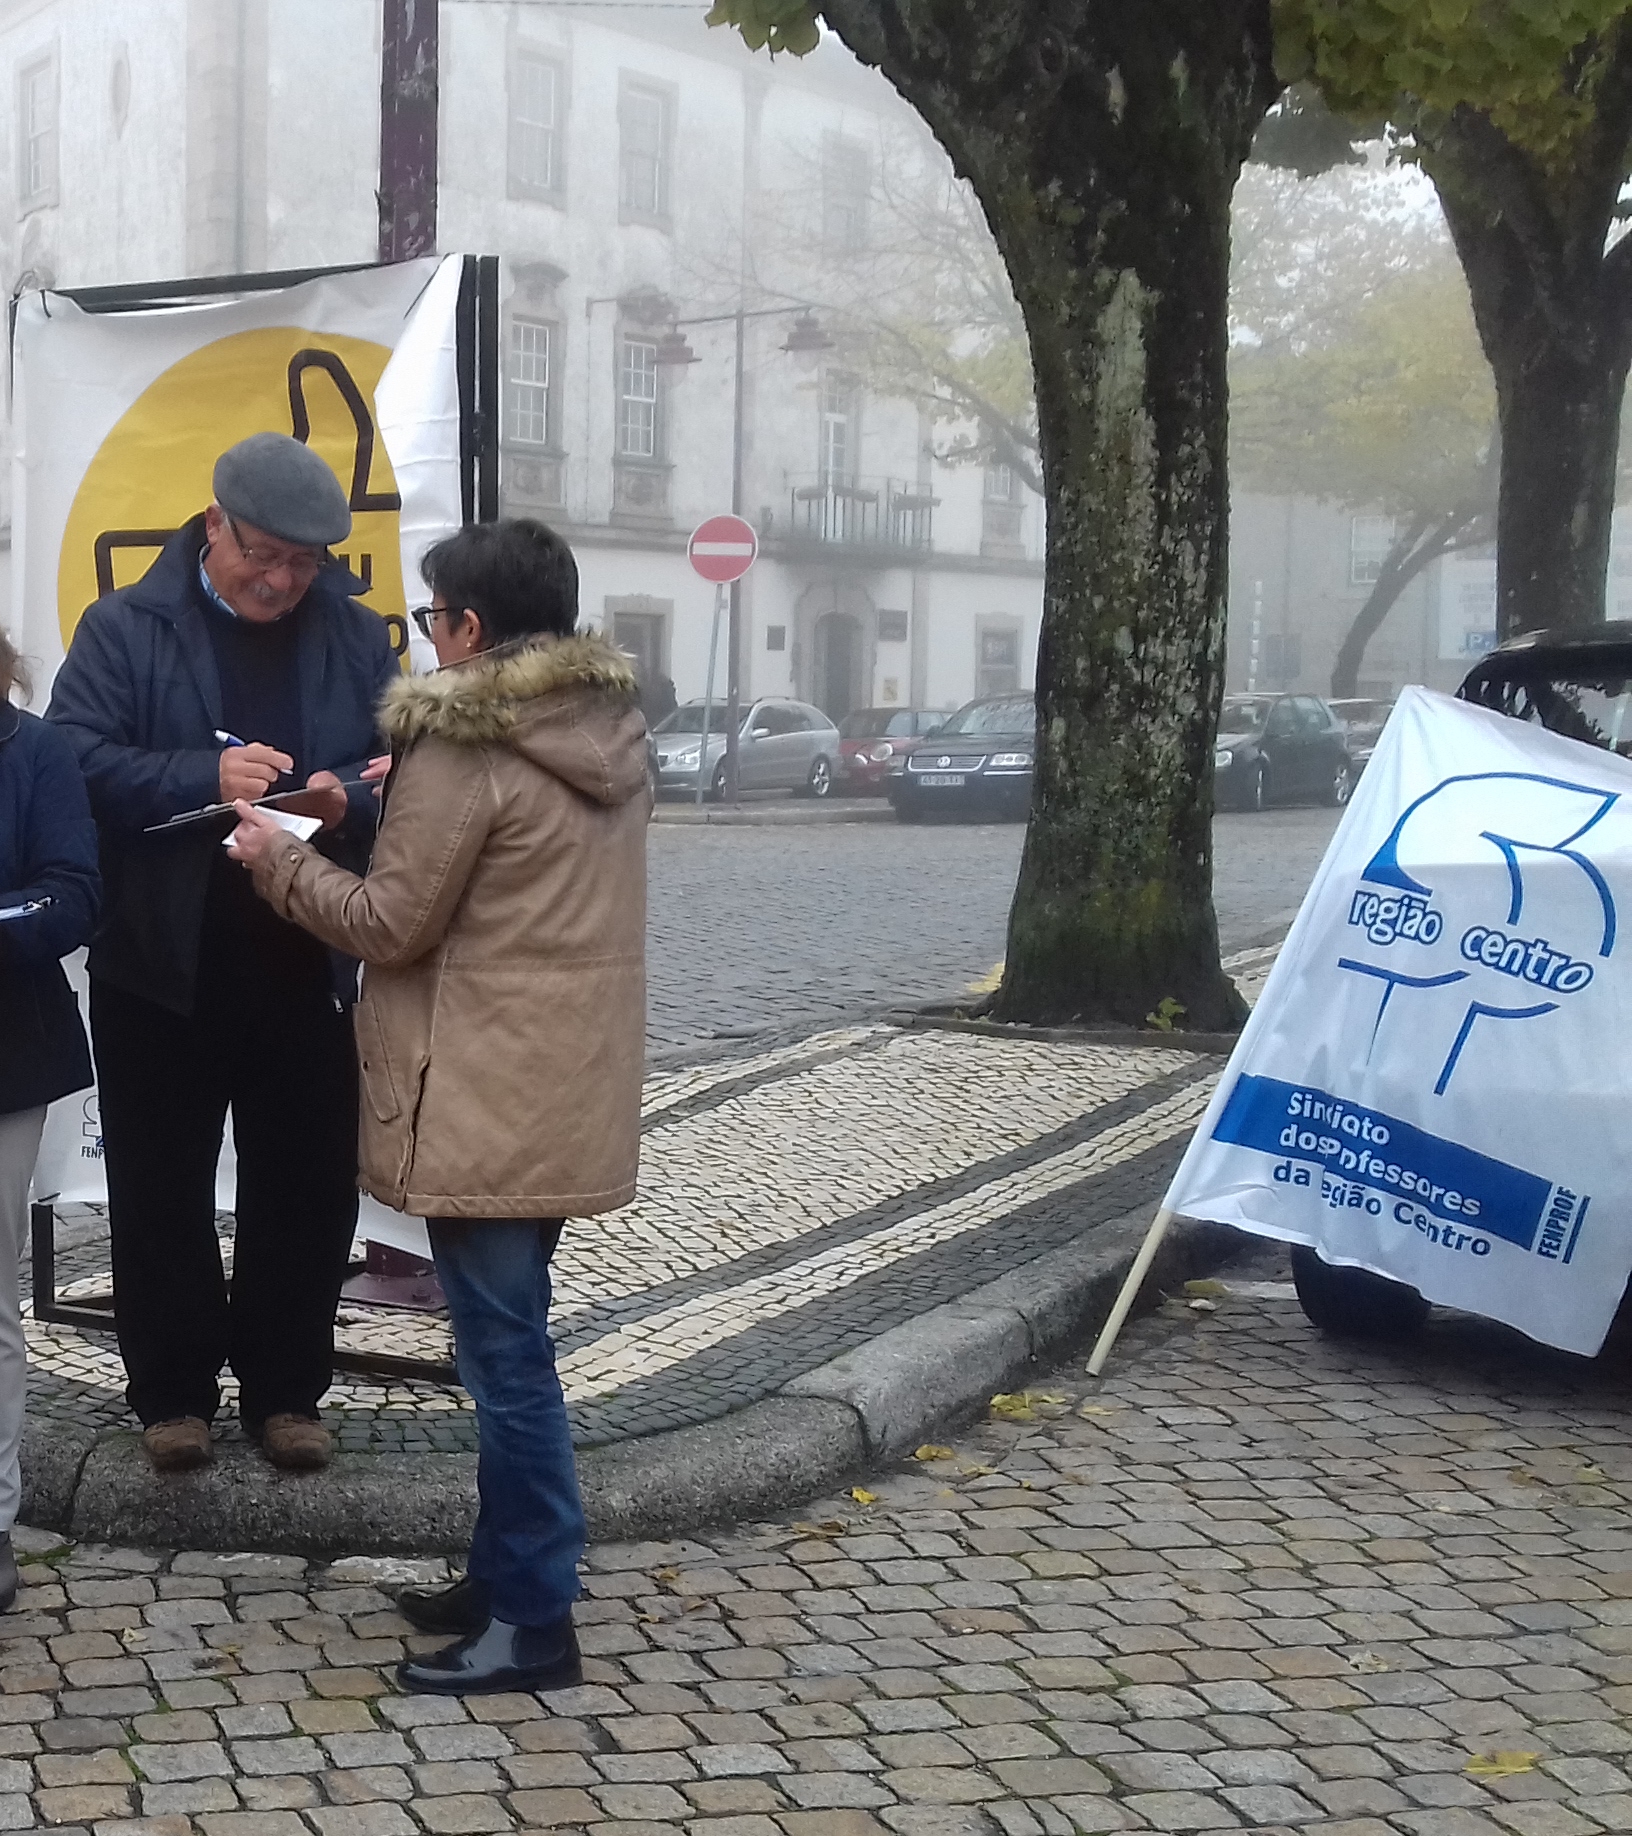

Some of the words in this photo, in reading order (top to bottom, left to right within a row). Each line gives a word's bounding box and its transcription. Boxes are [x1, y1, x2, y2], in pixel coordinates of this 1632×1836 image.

[1348, 889, 1444, 945] região
[1460, 925, 1594, 994] centro
[1273, 1160, 1311, 1187] da
[1393, 1202, 1492, 1257] Centro
[1536, 1185, 1578, 1260] FENPROF
